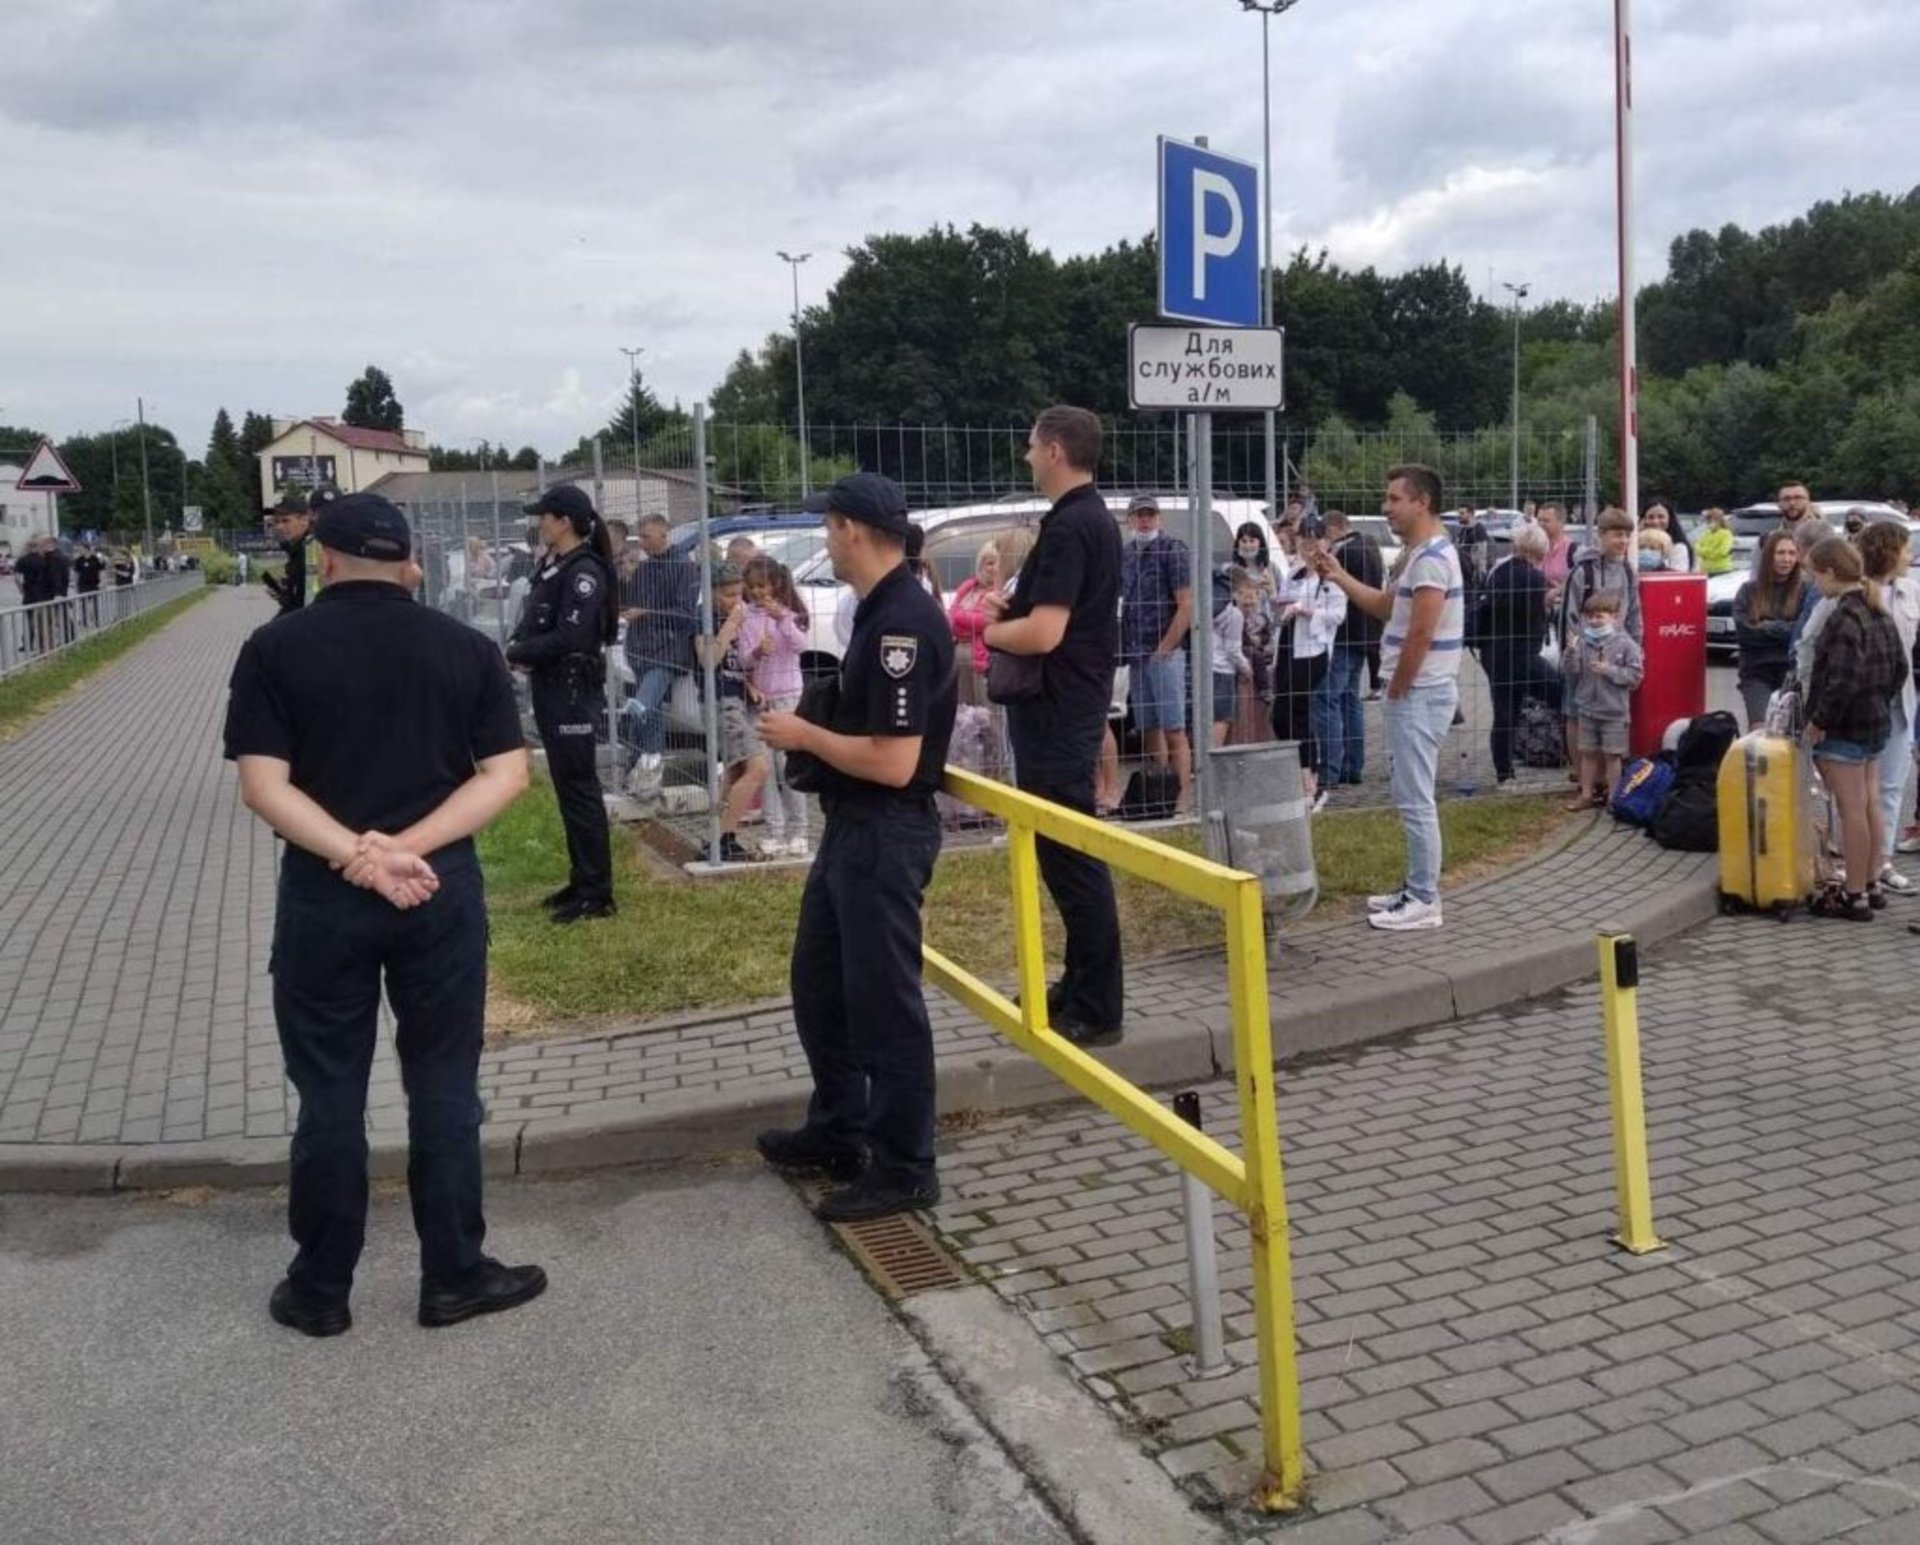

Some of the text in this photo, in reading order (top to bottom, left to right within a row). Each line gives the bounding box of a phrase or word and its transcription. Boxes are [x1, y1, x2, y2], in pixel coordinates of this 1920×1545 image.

[1193, 168, 1243, 300] P
[1185, 332, 1233, 356] Для
[1139, 358, 1276, 383] службових
[1188, 382, 1231, 402] а/м
